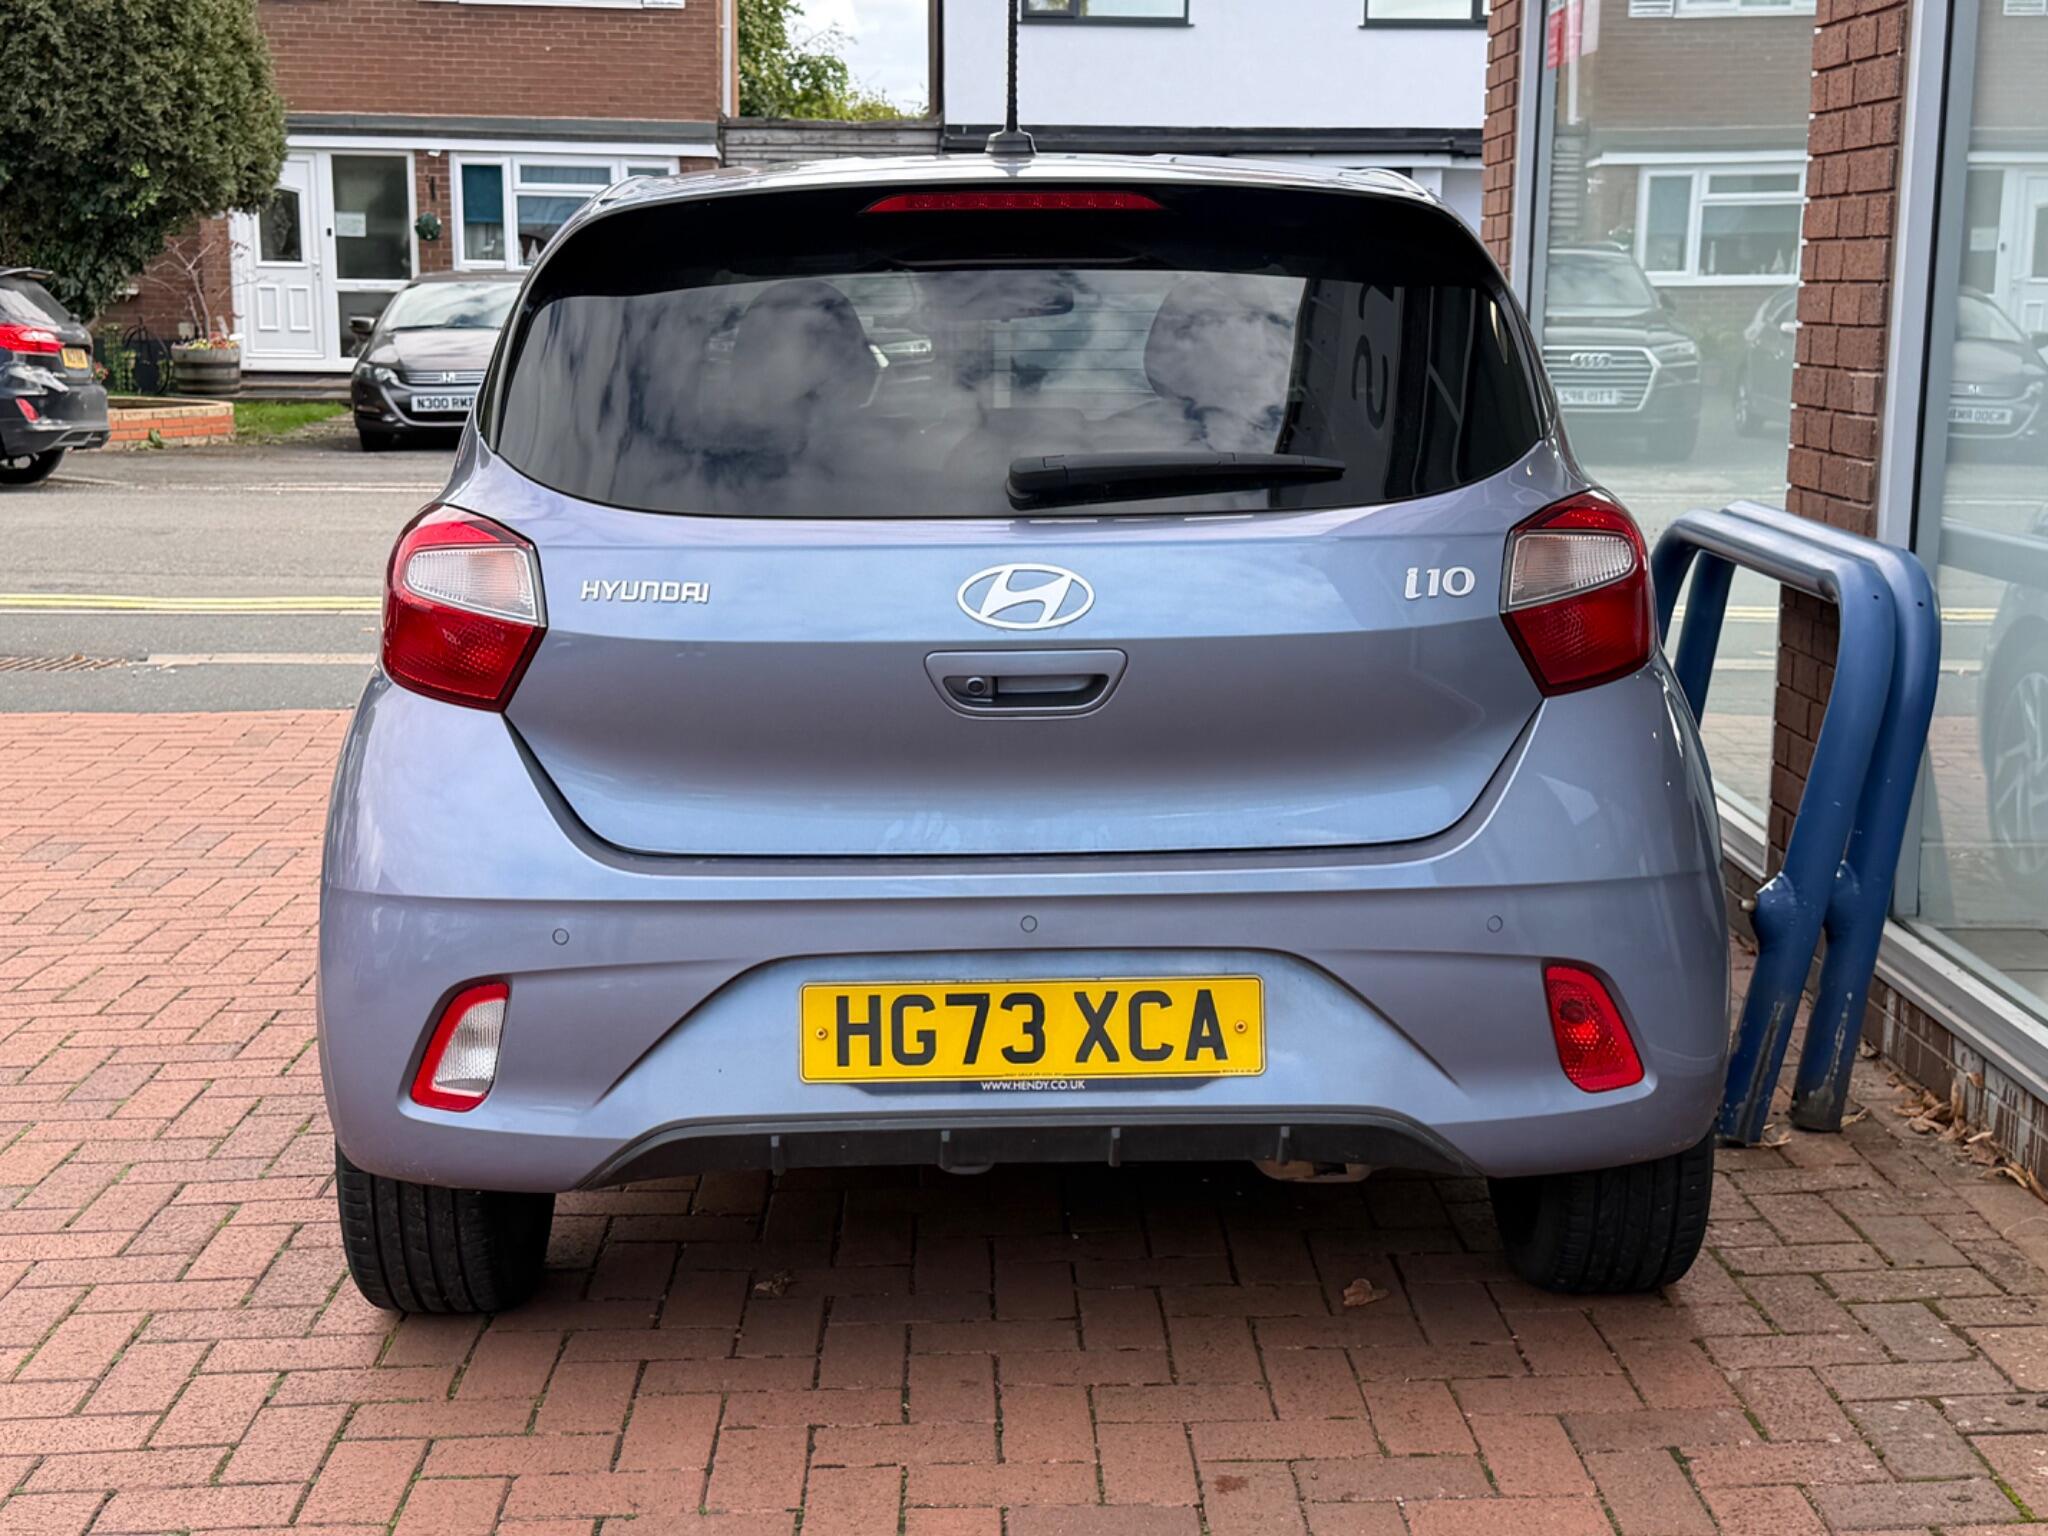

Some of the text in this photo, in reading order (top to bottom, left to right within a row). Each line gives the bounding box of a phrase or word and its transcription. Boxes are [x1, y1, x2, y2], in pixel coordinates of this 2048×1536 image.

[416, 397, 449, 409] N300
[580, 580, 710, 604] HYUNDAI
[835, 988, 1230, 1067] HG73 XCA
[980, 1080, 1086, 1091] WWW.HENDY.CO.UK
